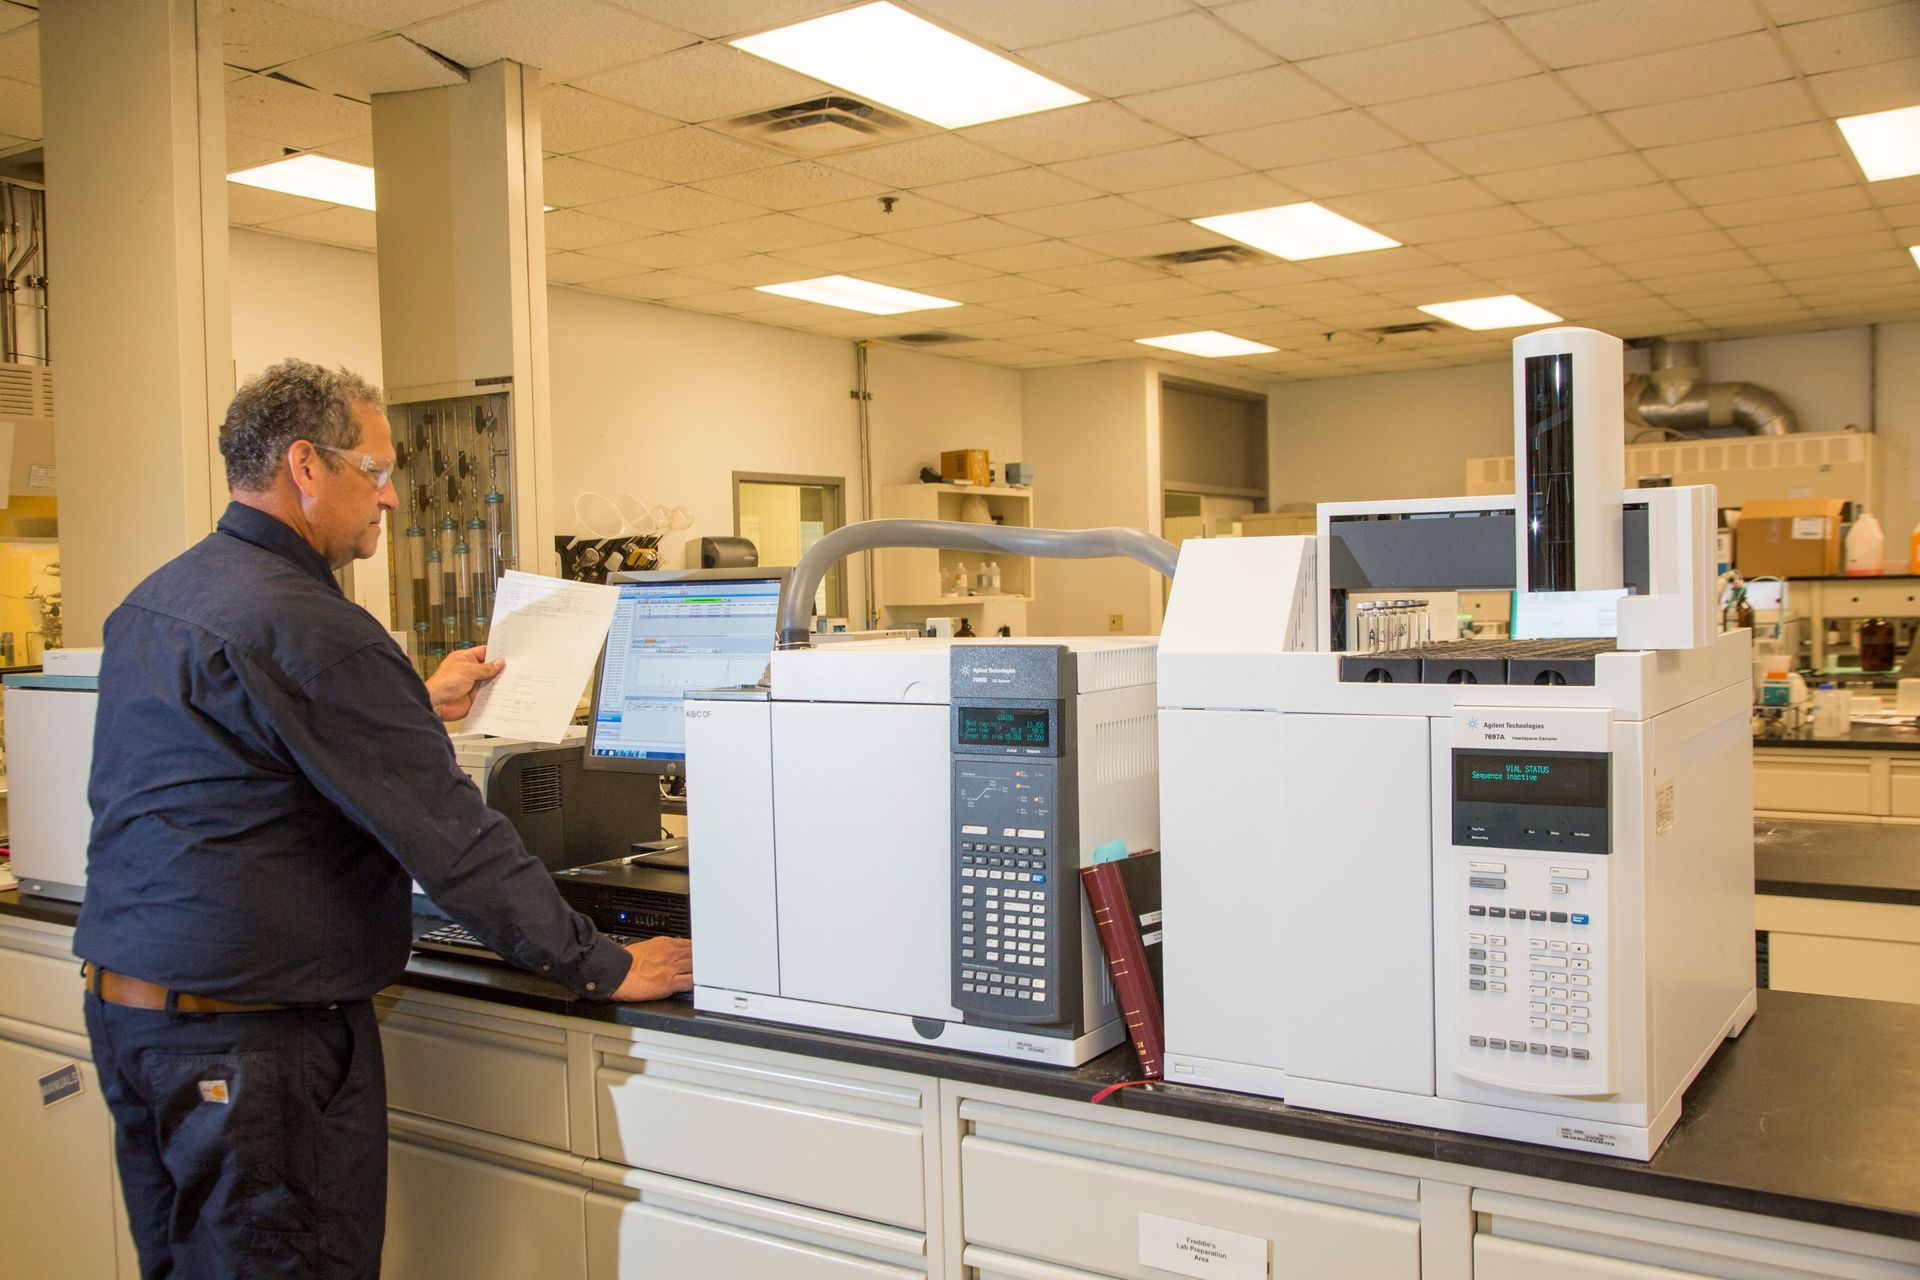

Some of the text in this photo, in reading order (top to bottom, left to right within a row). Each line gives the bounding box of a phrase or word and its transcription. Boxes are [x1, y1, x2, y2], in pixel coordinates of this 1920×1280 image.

[1506, 722, 1545, 730] Technologies
[1505, 765, 1549, 774] VIAL STATUS
[1471, 770, 1503, 780] Sequence
[1186, 1237, 1216, 1249] Freddie's
[1176, 1242, 1227, 1259] Lab Preparation
[1194, 1254, 1209, 1263] Area
